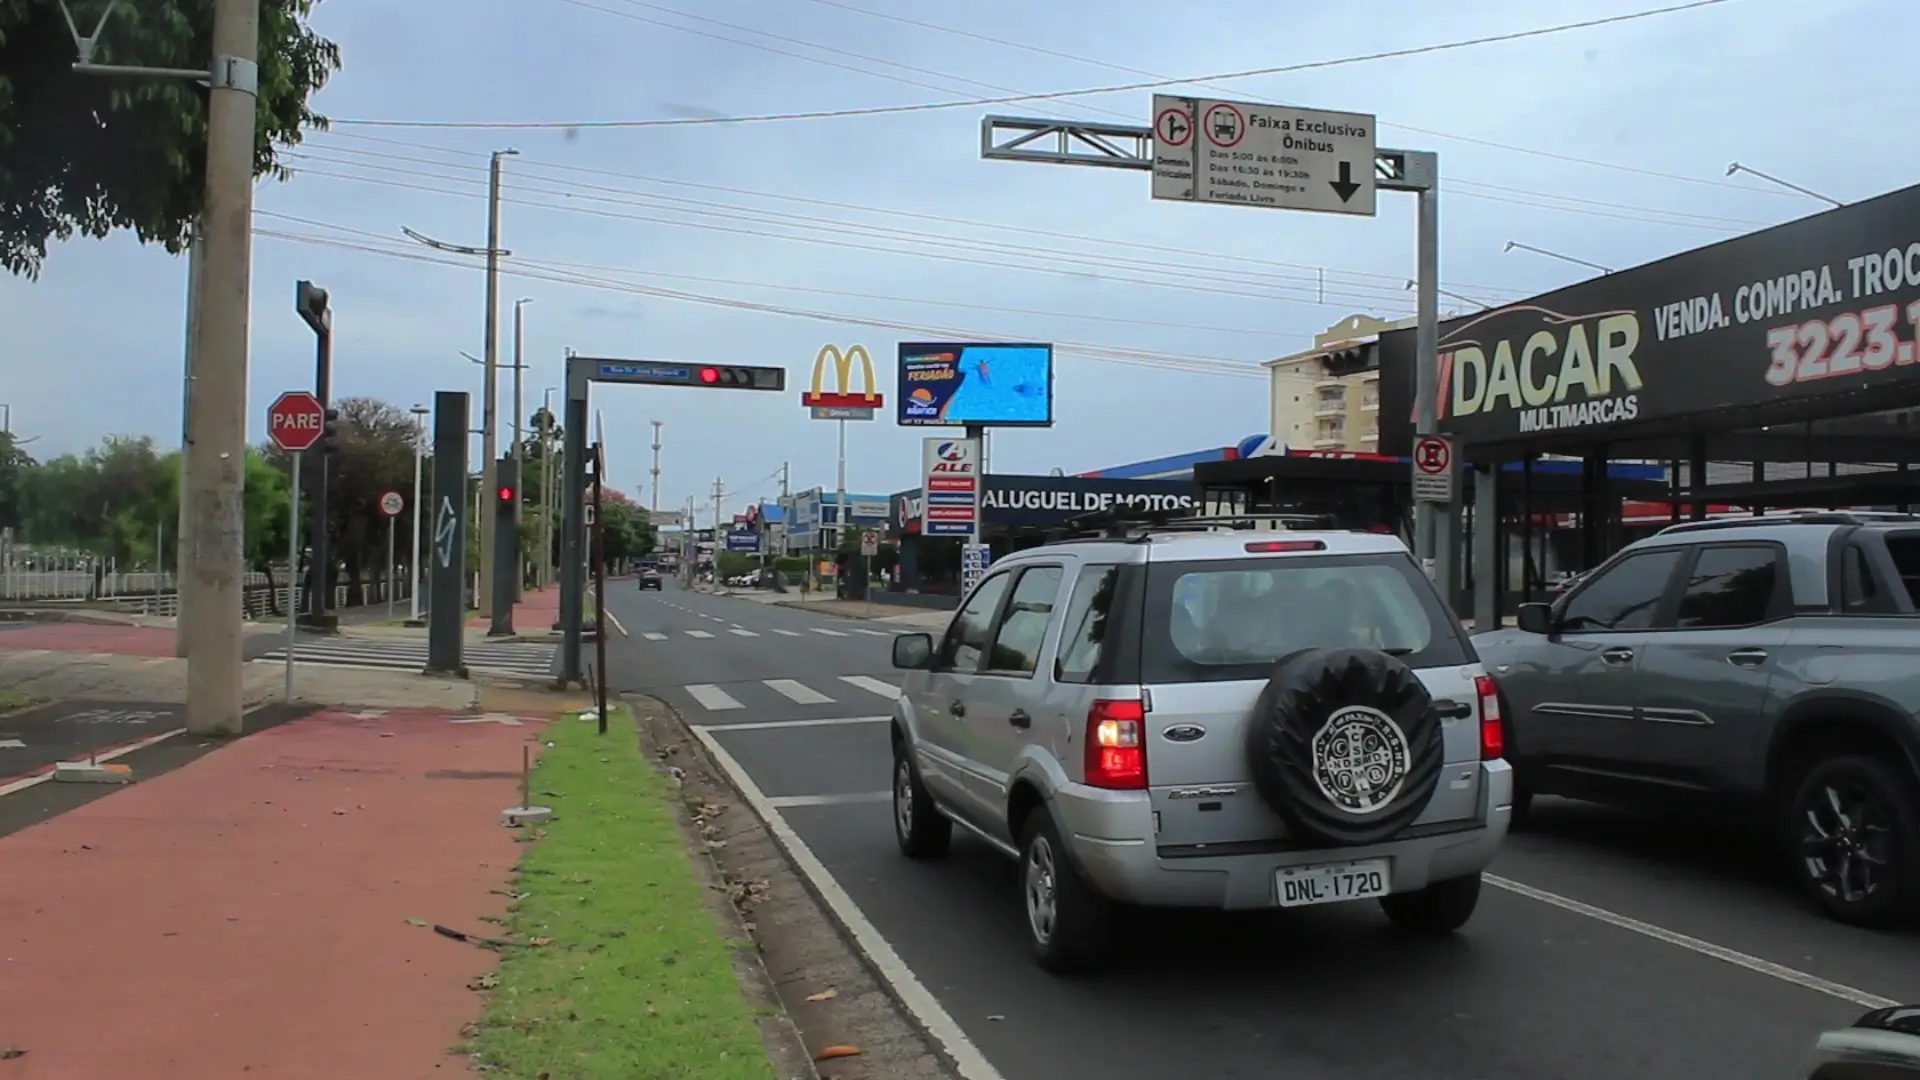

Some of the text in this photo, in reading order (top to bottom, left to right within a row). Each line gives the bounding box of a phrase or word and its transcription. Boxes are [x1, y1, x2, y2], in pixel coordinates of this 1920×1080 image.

[1250, 114, 1366, 138] Faixa Exclusiva
[1283, 133, 1334, 153] Ônibus
[1654, 292, 1731, 341] VENDA.
[1734, 265, 1843, 325] COMPRA.
[273, 413, 320, 429] PARE
[1519, 394, 1639, 433] MULTIMARCAS
[932, 462, 974, 473] ALE
[982, 489, 1082, 511] ALUGUEL
[1084, 492, 1113, 512] DE
